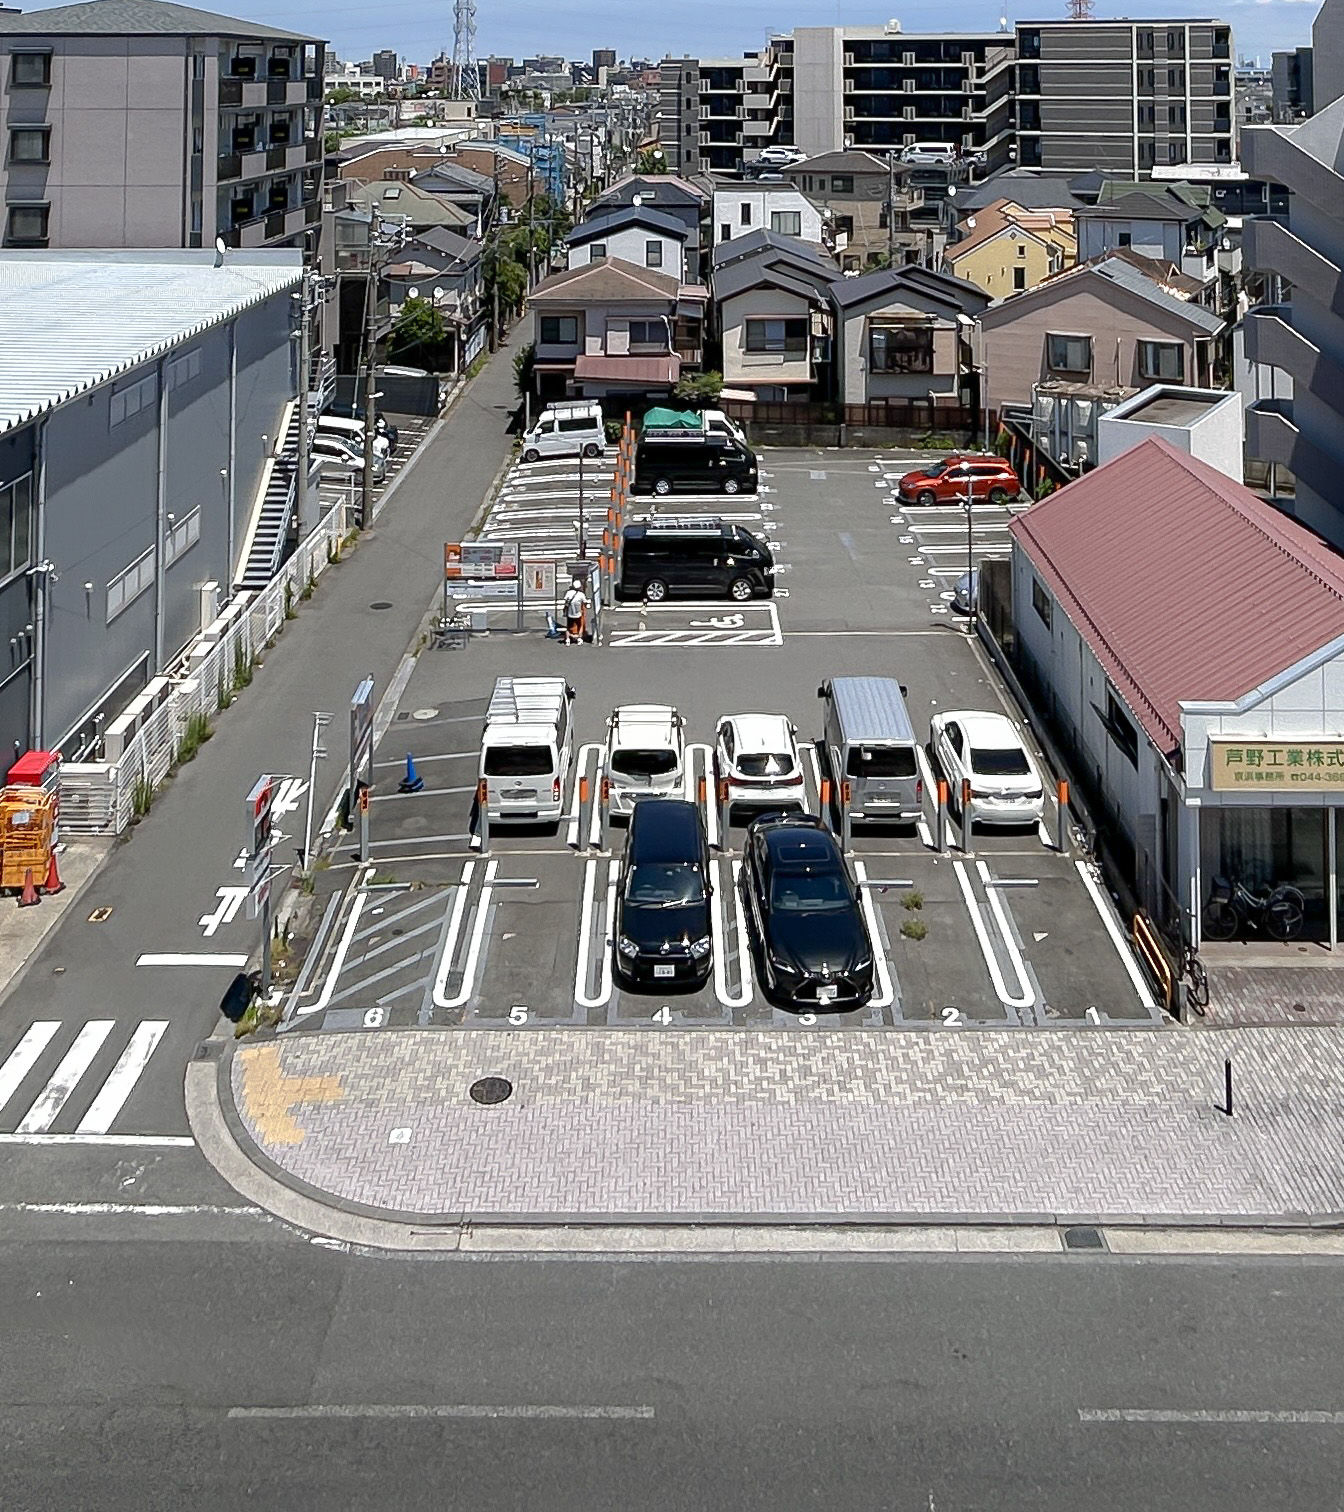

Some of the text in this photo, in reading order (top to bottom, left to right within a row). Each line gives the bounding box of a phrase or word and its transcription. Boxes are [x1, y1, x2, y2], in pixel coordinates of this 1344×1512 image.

[362, 1007, 384, 1028] 6
[508, 1006, 529, 1025] 5
[651, 1006, 673, 1026] 4
[941, 1007, 963, 1027] 2
[1085, 1006, 1101, 1026] 1
